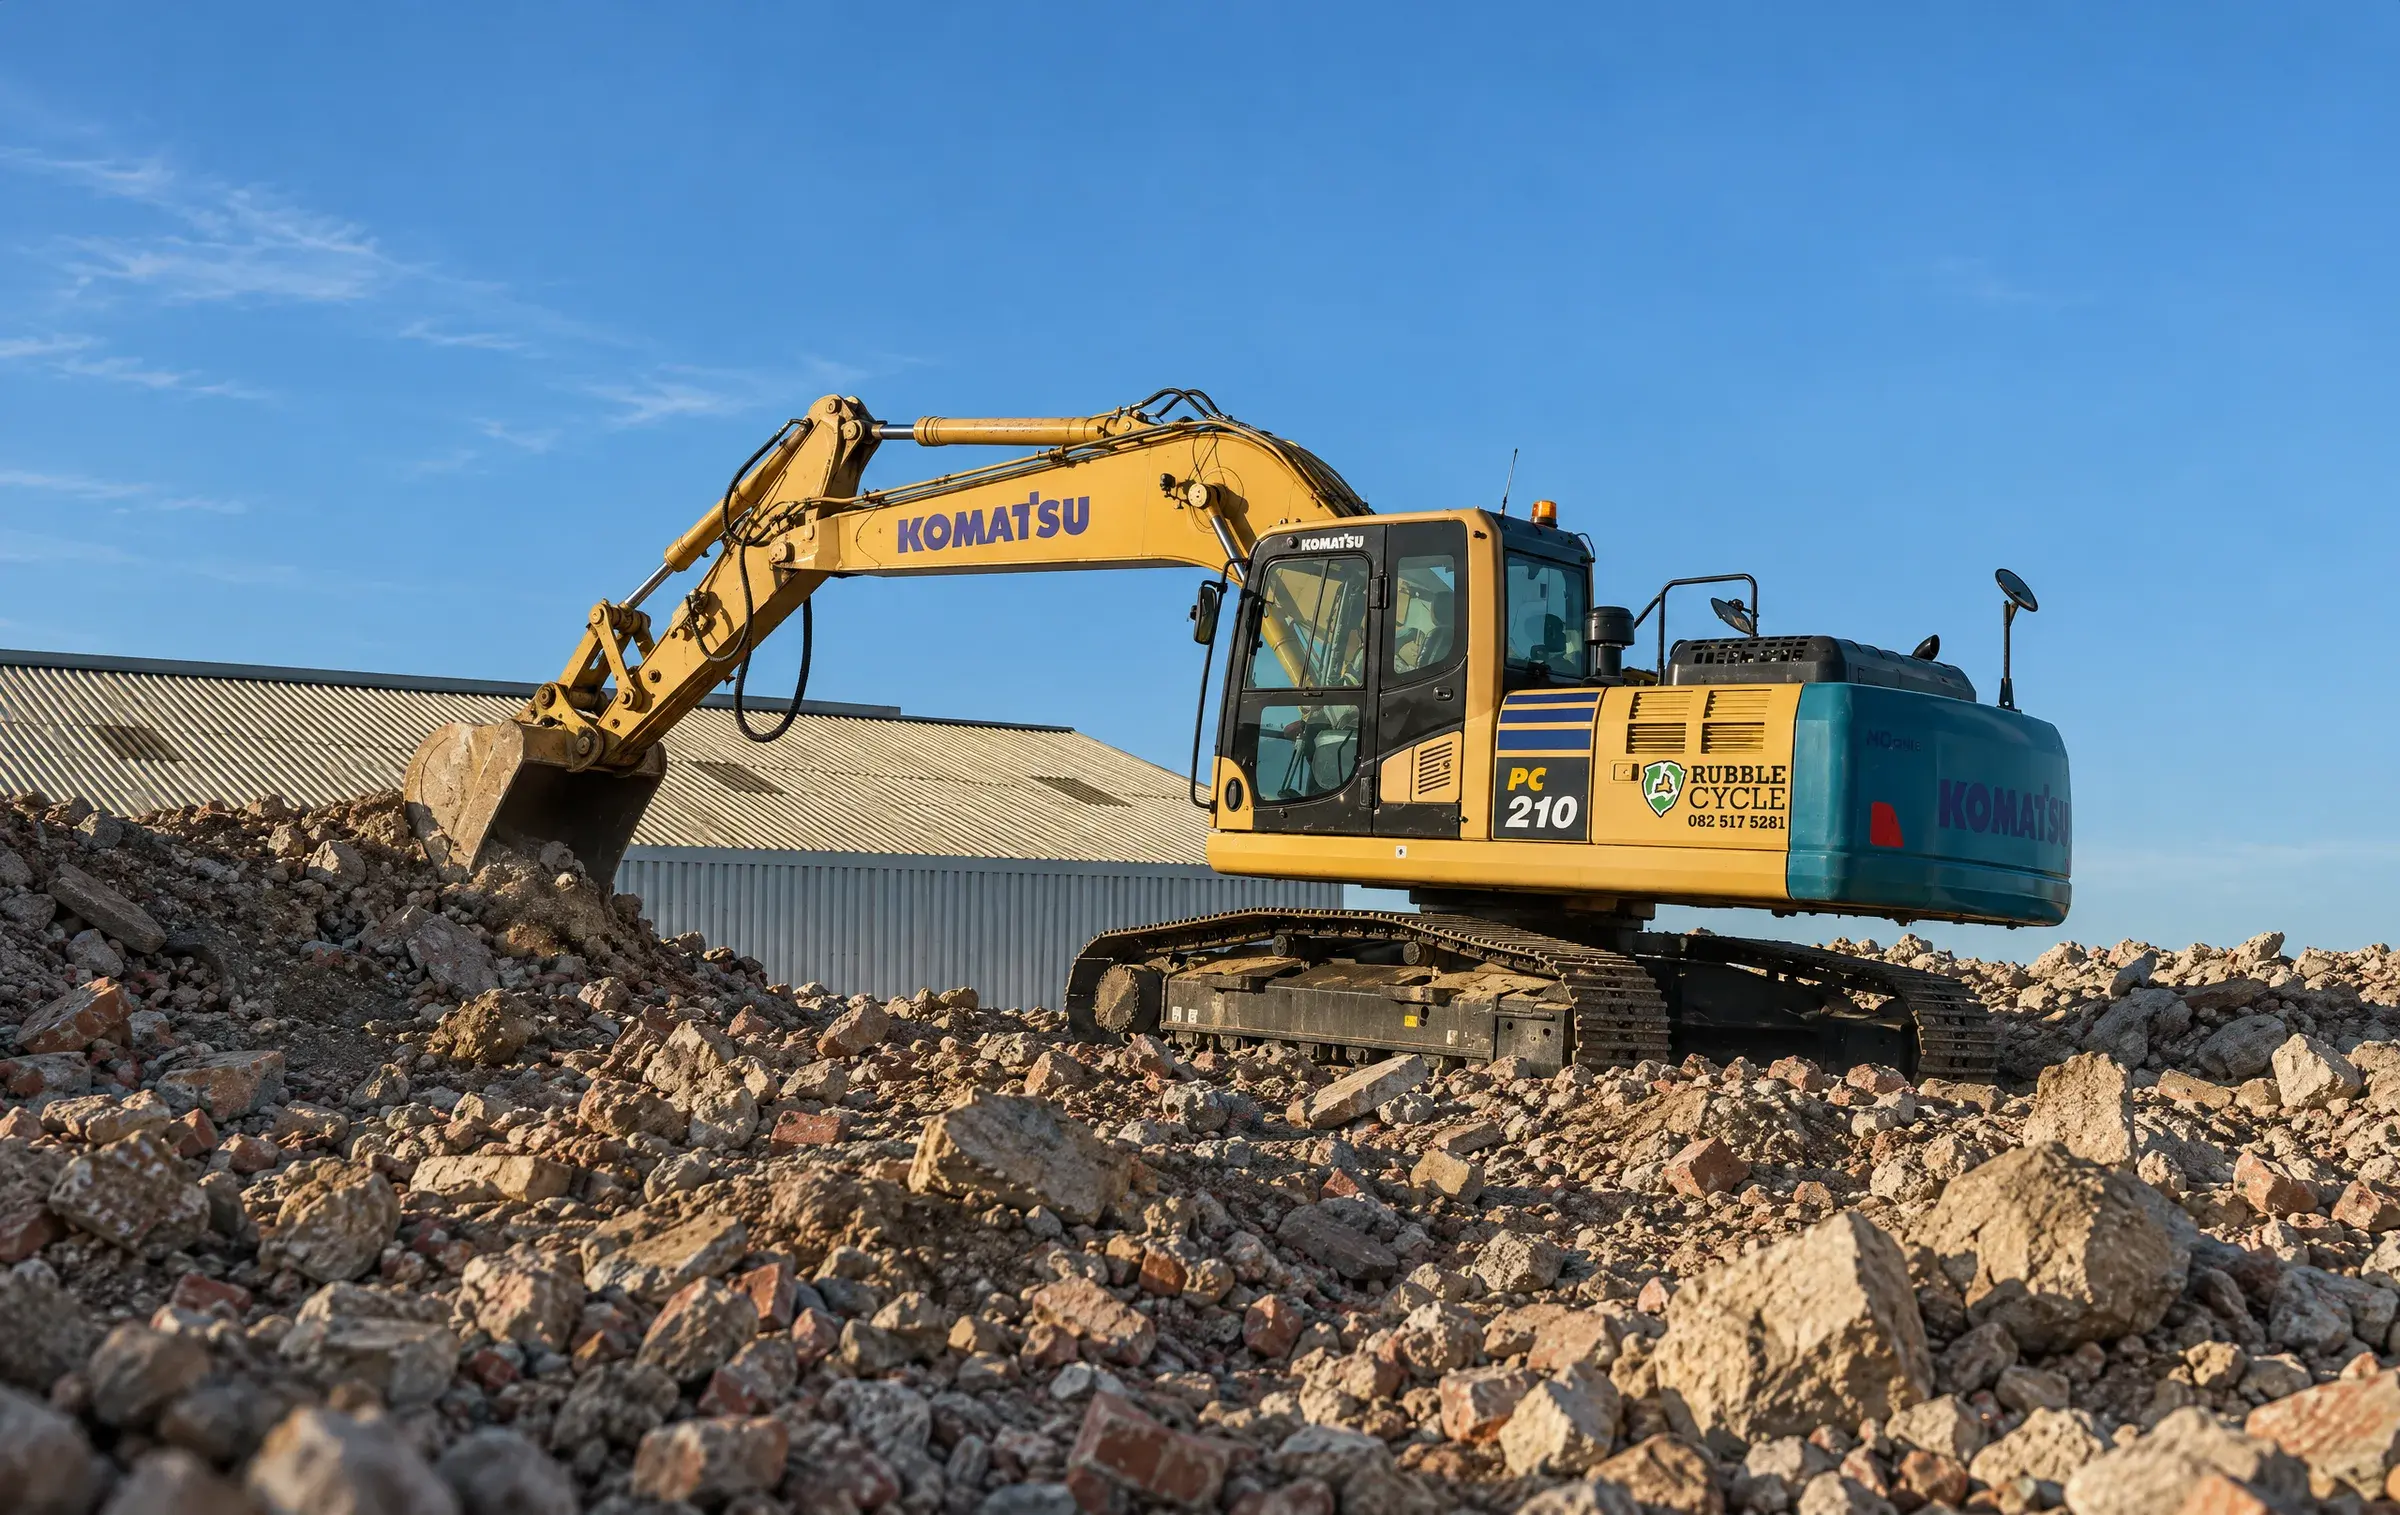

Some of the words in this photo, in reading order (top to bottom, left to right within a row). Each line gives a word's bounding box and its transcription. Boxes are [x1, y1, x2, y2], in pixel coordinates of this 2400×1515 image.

[898, 491, 1090, 554] KOMATSU
[1301, 533, 1364, 551] KOMATSU
[1507, 767, 1547, 791] PC
[1690, 765, 1786, 784] RUBBLE
[1689, 787, 1785, 810] CYCLE
[1505, 795, 1578, 829] 210
[1688, 815, 1715, 828] 082
[1719, 815, 1745, 829] 517
[1750, 816, 1785, 830] 5281
[1938, 779, 2069, 848] KOMATSU
